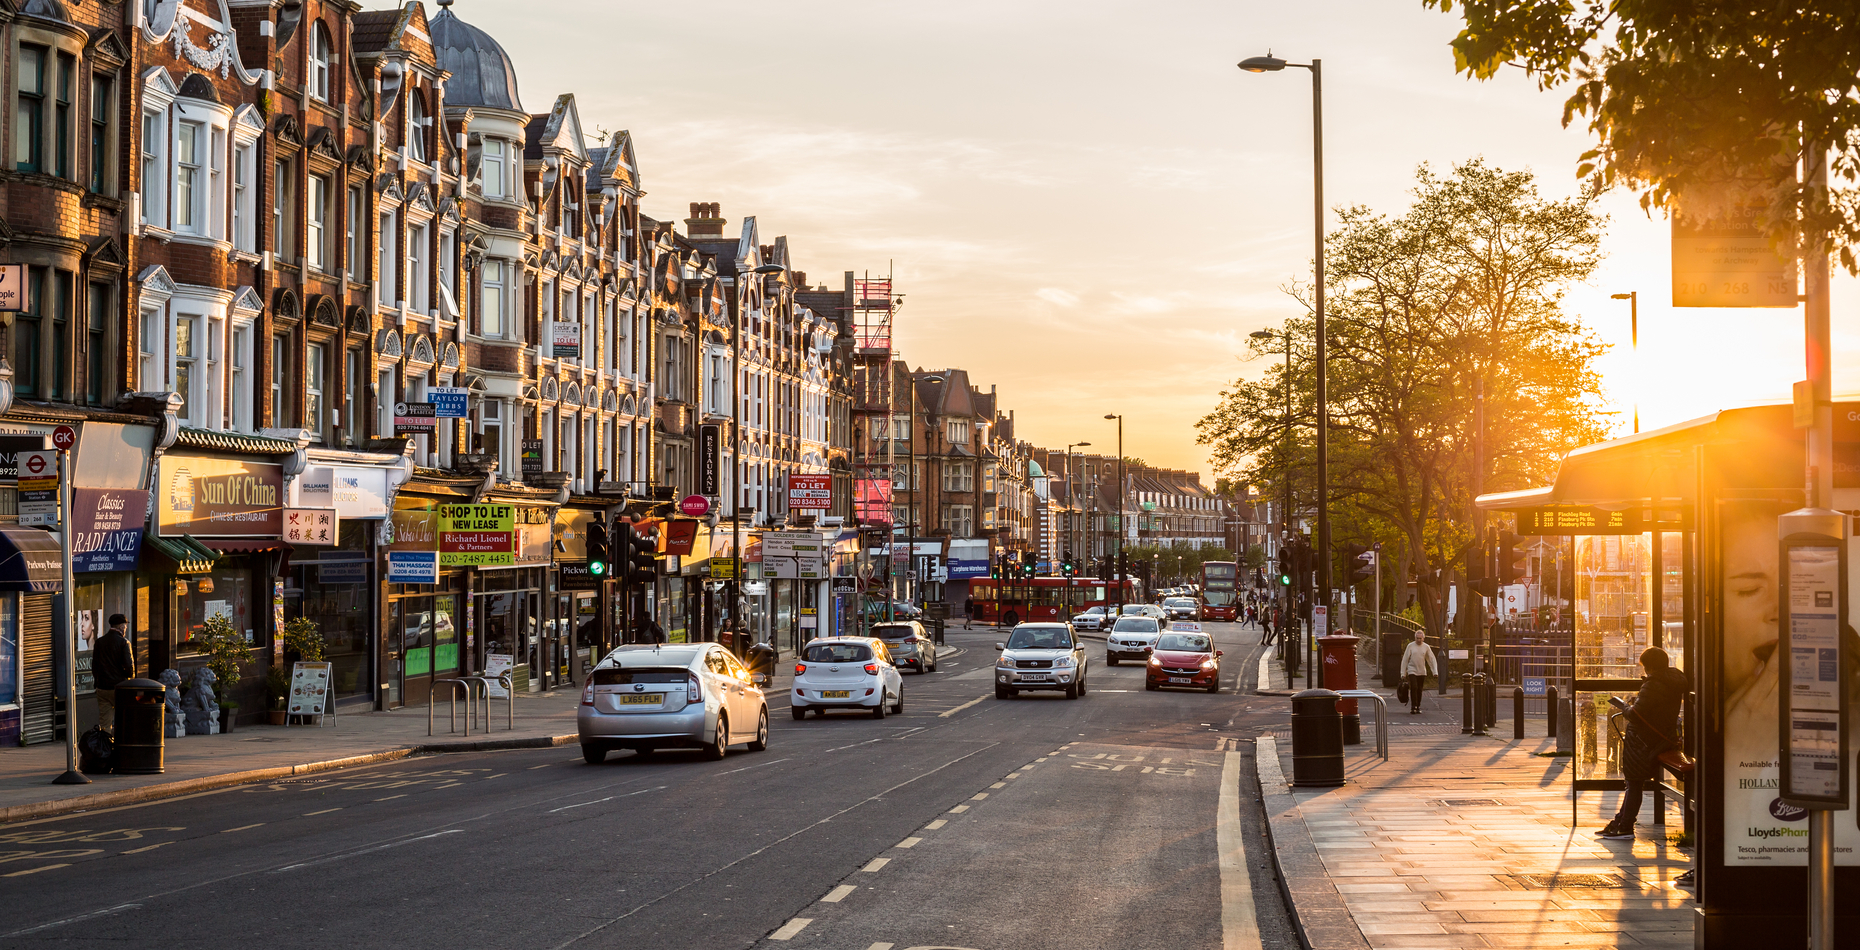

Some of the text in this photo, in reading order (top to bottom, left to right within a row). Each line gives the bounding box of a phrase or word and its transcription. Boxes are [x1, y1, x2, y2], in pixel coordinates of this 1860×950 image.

[1695, 246, 1775, 255] towards Hampstea
[1723, 257, 1759, 266] Archway
[1680, 282, 1788, 295] 210 268 N5
[430, 394, 465, 402] TAYLOR
[55, 432, 72, 444] GK
[201, 473, 277, 506] Sun Of China
[97, 493, 125, 511] Classics
[210, 510, 268, 522] CHINESE RESTAURANT
[441, 506, 471, 518] SHOP
[473, 506, 488, 518] TO
[491, 506, 510, 518] LET
[452, 520, 499, 529] NEW LEASE
[73, 531, 137, 553] RADIANCE
[444, 534, 507, 543] Richard Lionel
[91, 554, 110, 562] Aesthetics
[488, 554, 510, 563] 4451
[47, 559, 62, 570] Patisse
[563, 566, 588, 574] Pickwi
[437, 600, 453, 610] TO LET
[622, 695, 660, 704] LX65 FLH
[1739, 778, 1780, 790] HOLLAN
[1738, 845, 1757, 853] Tesco,
[1758, 845, 1795, 854] pharmacies
